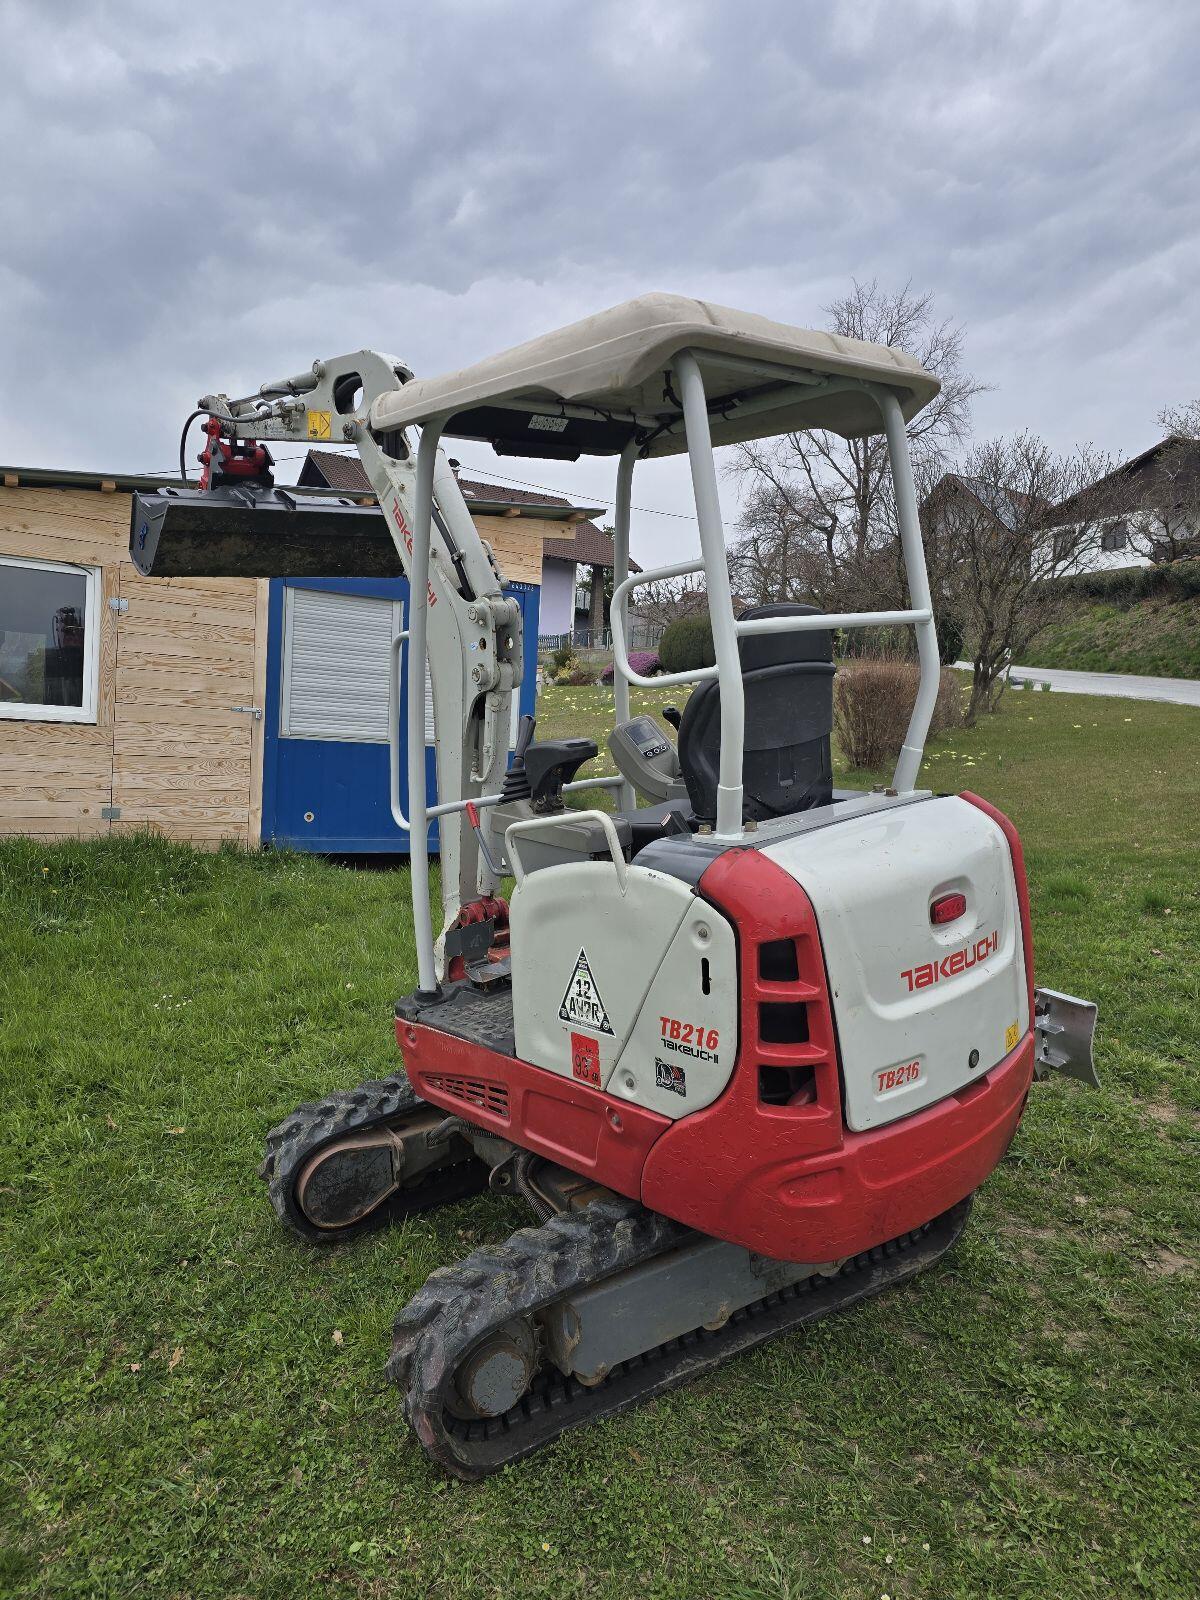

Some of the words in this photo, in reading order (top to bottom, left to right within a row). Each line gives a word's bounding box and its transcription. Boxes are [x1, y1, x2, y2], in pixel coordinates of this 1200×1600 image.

[900, 929, 998, 992] TAKEUCHI
[575, 978, 591, 999] 12
[659, 1015, 719, 1051] TB216
[660, 1038, 719, 1065] TAKEUCHI
[877, 1060, 920, 1092] TB216
